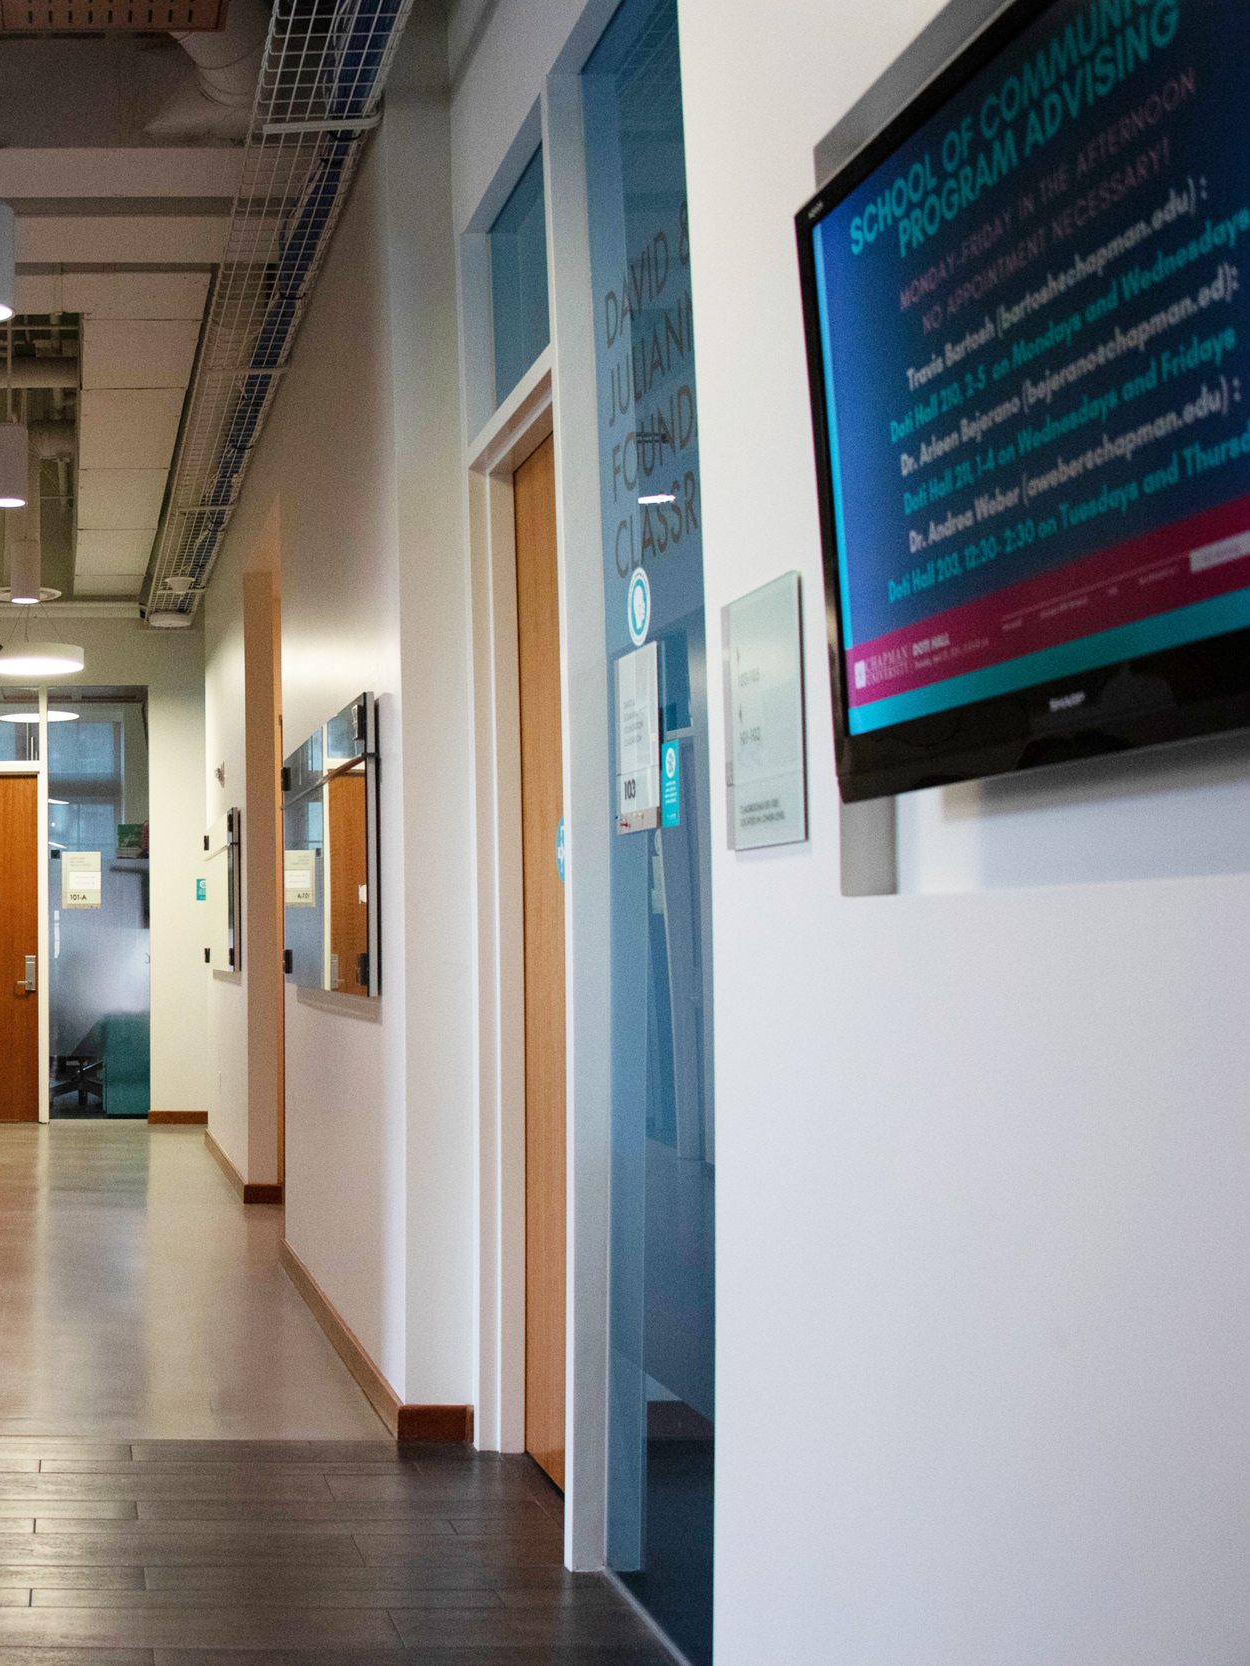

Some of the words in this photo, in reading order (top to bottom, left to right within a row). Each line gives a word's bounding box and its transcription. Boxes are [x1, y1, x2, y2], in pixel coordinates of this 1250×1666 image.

[849, 154, 937, 256] SCHOOL
[940, 115, 973, 173] OF
[979, 0, 1150, 140] COMMUN
[898, 130, 1016, 259] PROGRAM
[1024, 0, 1179, 157] ADVISING
[899, 208, 1011, 313] MONDAY-FRIDAY
[1018, 193, 1035, 220] IN
[1039, 163, 1068, 205] THE
[1076, 66, 1196, 181] AFTERNOON
[605, 231, 669, 348] DAVID
[922, 305, 941, 336] NO
[946, 229, 1044, 321] APPOINTMENT
[1051, 136, 1169, 245] NECESSARY!
[890, 411, 913, 444] Doti
[914, 394, 938, 429] Hall
[992, 358, 1010, 381] on
[1011, 313, 1082, 369] Mondays
[1085, 279, 1119, 324] and
[1121, 207, 1250, 301] Wednesdays
[906, 354, 944, 392] Travis
[944, 316, 995, 368] Bartosh
[612, 385, 698, 503] FOUND
[900, 452, 918, 477] Dr.
[919, 432, 959, 467] Arleen
[960, 397, 1020, 443] Bejerano
[903, 484, 927, 516] Doti
[928, 469, 953, 502] Hall
[998, 444, 1016, 466] on
[1016, 390, 1118, 456] Wednesdays
[1121, 357, 1157, 402] and
[1161, 327, 1236, 381] Fridays
[615, 471, 699, 578] CLASSR
[888, 574, 910, 603] Doti
[912, 562, 935, 592] Hall
[1038, 517, 1057, 539] on
[1059, 481, 1139, 529] Tuesdays
[1142, 452, 1179, 494] and
[909, 529, 926, 554] Dr.
[927, 510, 973, 545] Andrea
[974, 487, 1019, 522] Weber
[624, 779, 636, 800] 103
